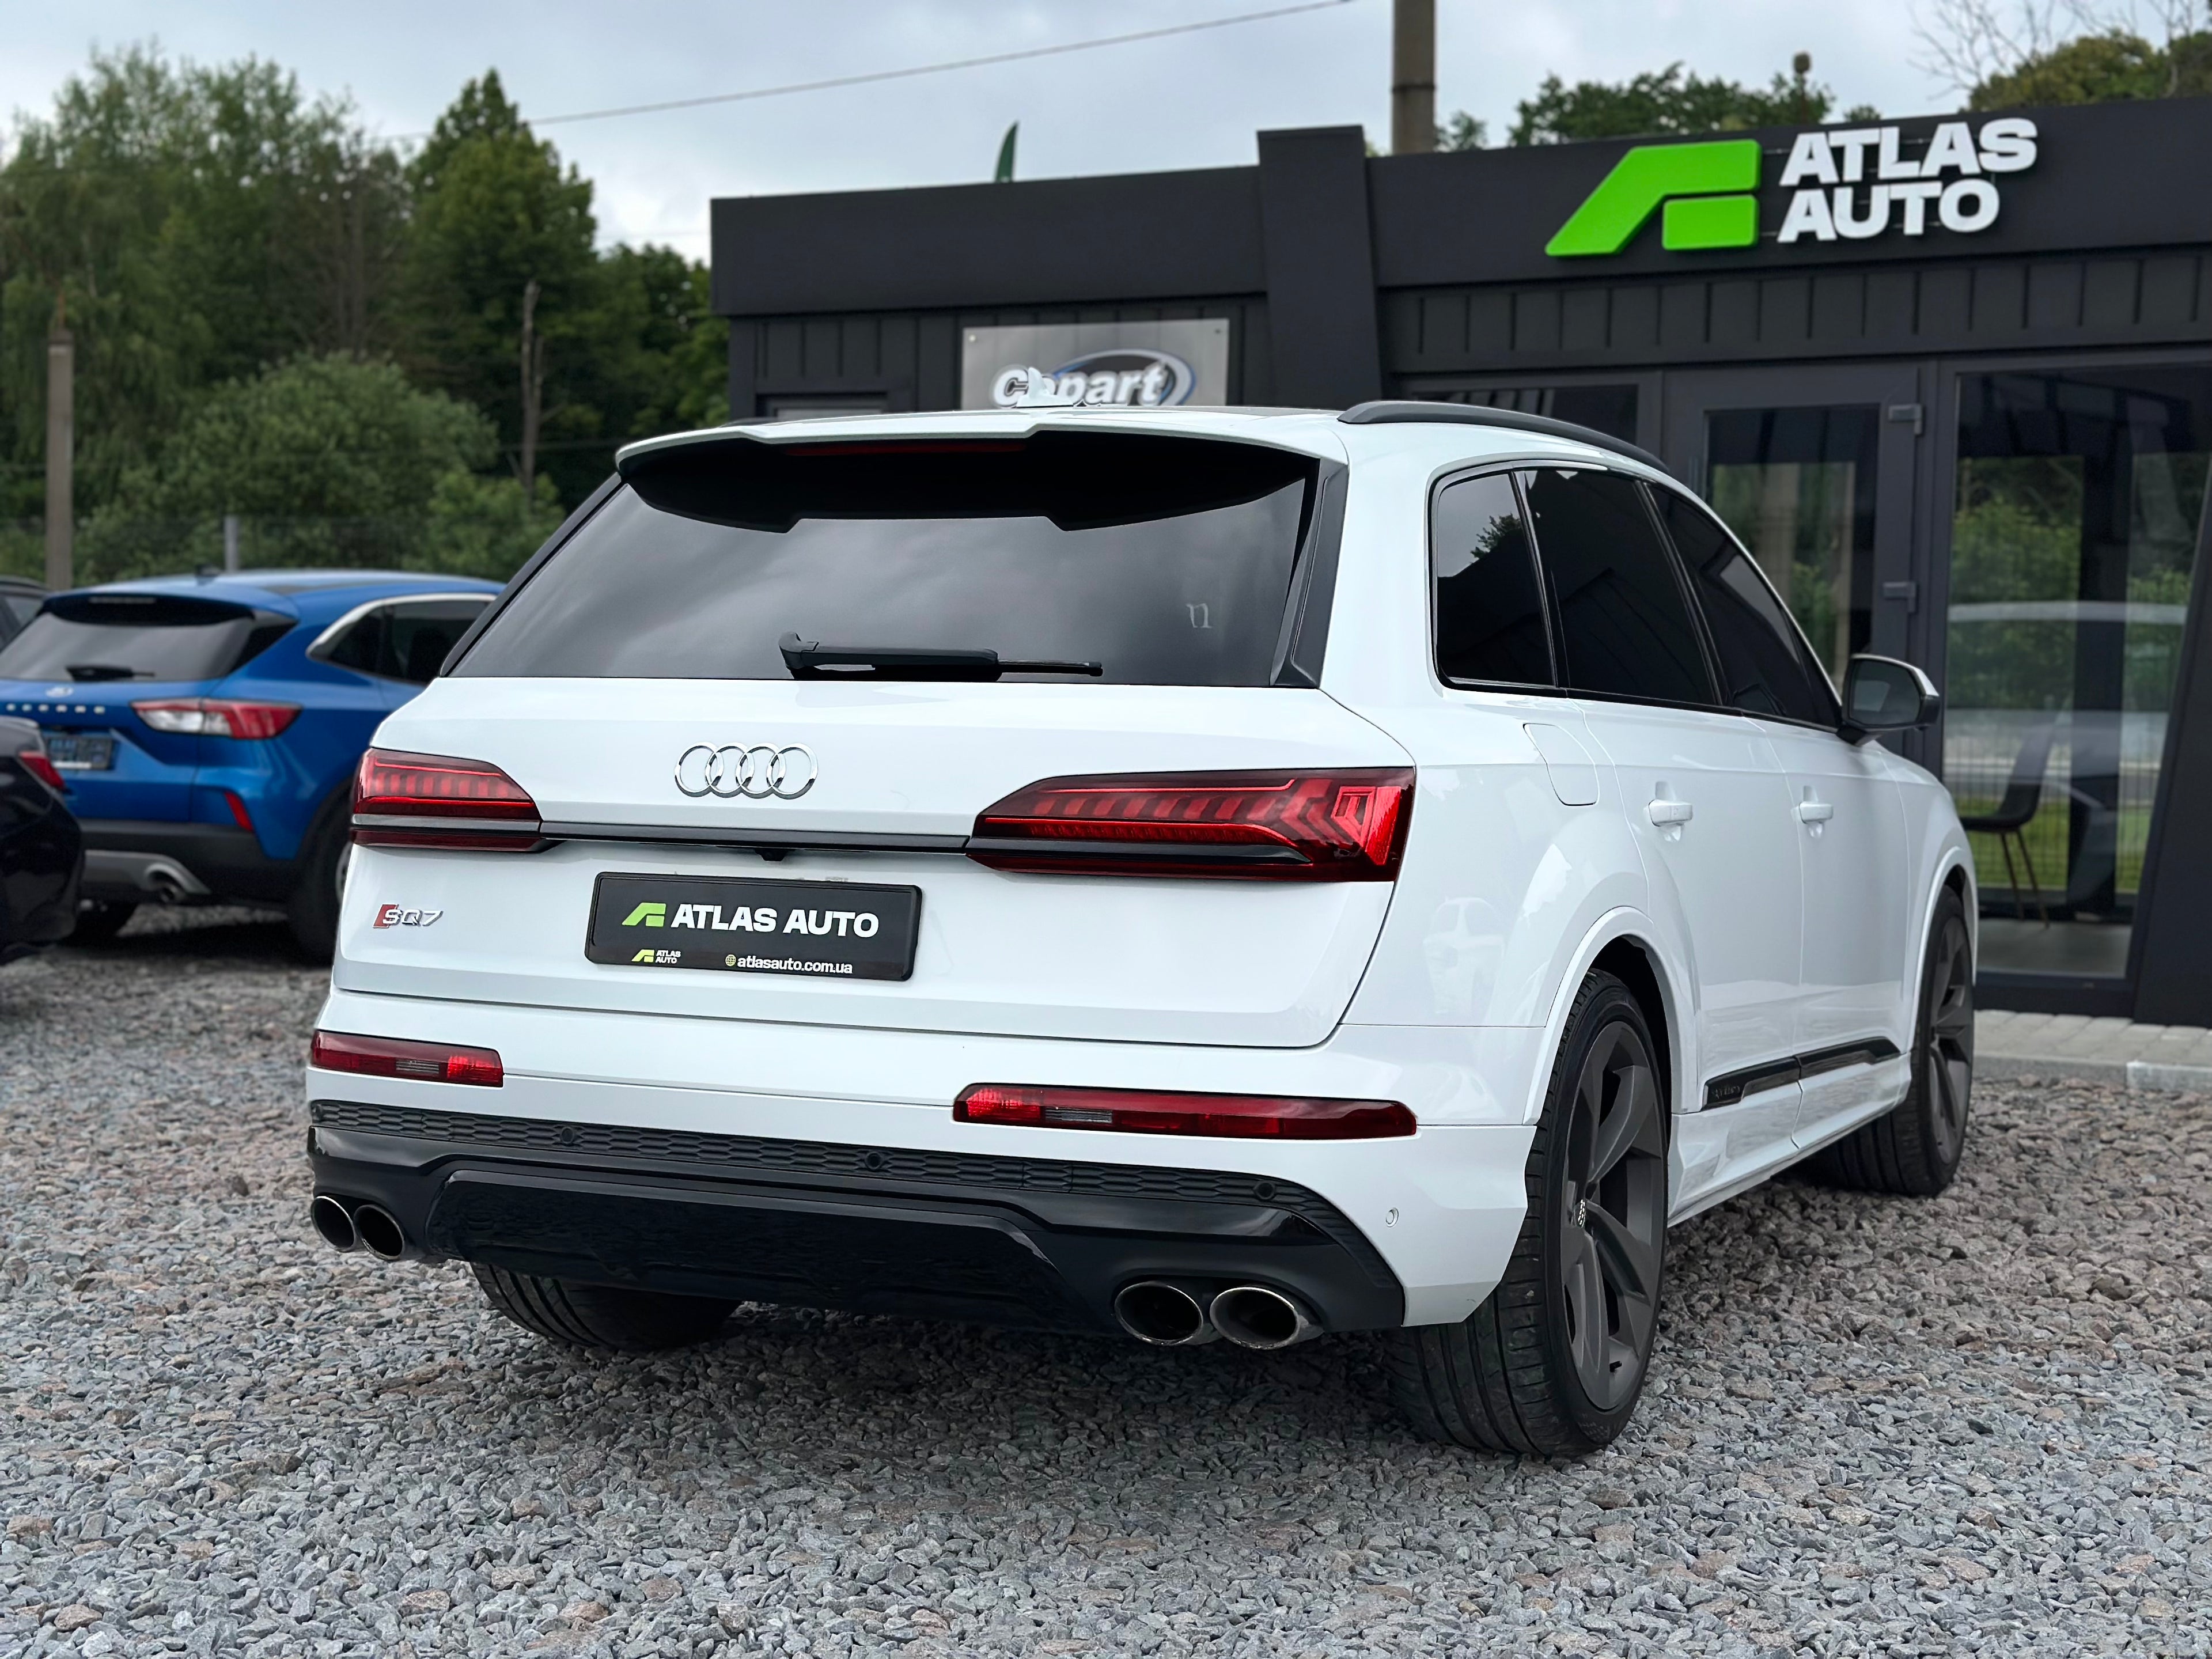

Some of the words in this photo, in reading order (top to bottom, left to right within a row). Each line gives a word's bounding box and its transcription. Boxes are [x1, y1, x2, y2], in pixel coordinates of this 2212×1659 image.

[1779, 118, 2038, 187] ATLAS
[1777, 178, 2001, 243] AUTO
[382, 908, 444, 927] SQ7
[671, 903, 778, 933] ATLAS
[782, 908, 879, 938] AUTO
[655, 956, 677, 964] AUTO
[656, 949, 681, 957] ATLAS
[737, 955, 853, 974] atlasauto.com.ua
